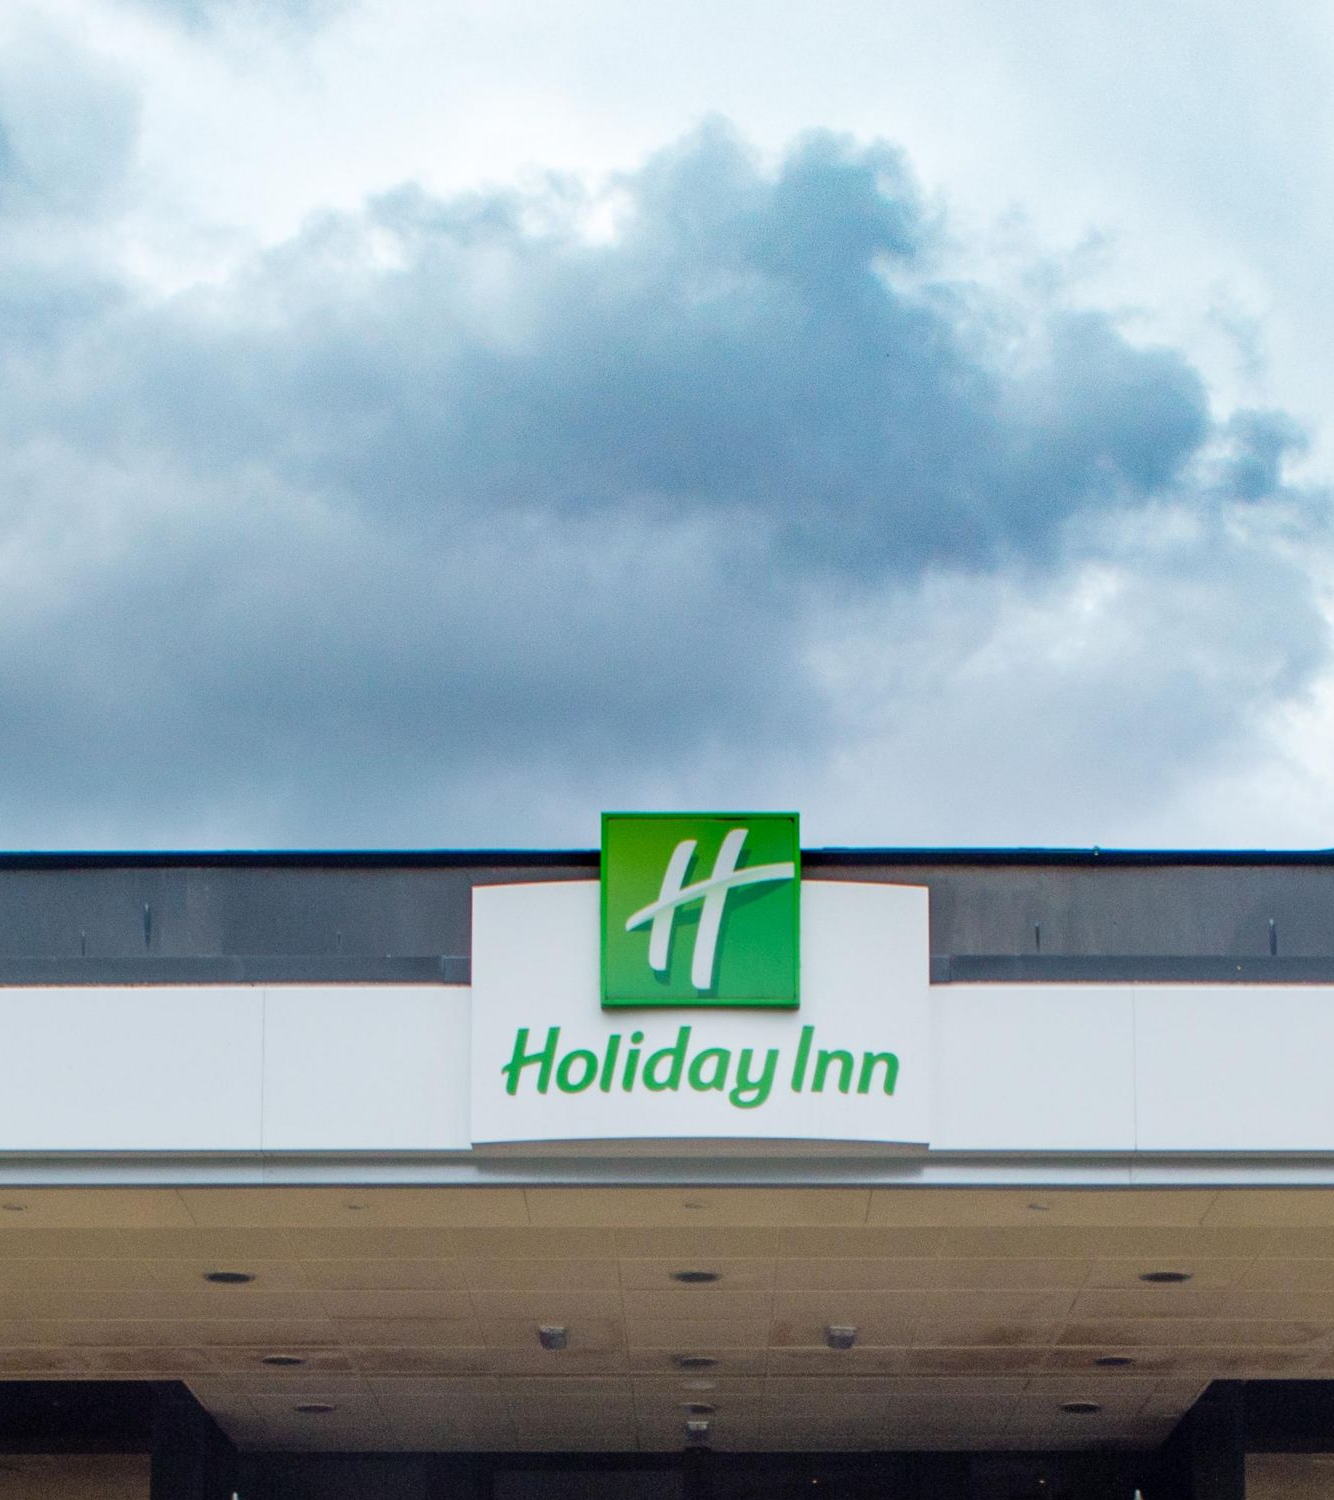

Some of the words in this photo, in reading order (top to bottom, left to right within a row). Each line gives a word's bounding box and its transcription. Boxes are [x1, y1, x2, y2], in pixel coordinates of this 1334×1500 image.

[625, 828, 795, 990] H
[500, 1025, 780, 1109] Holiday
[790, 1025, 900, 1096] Inn
